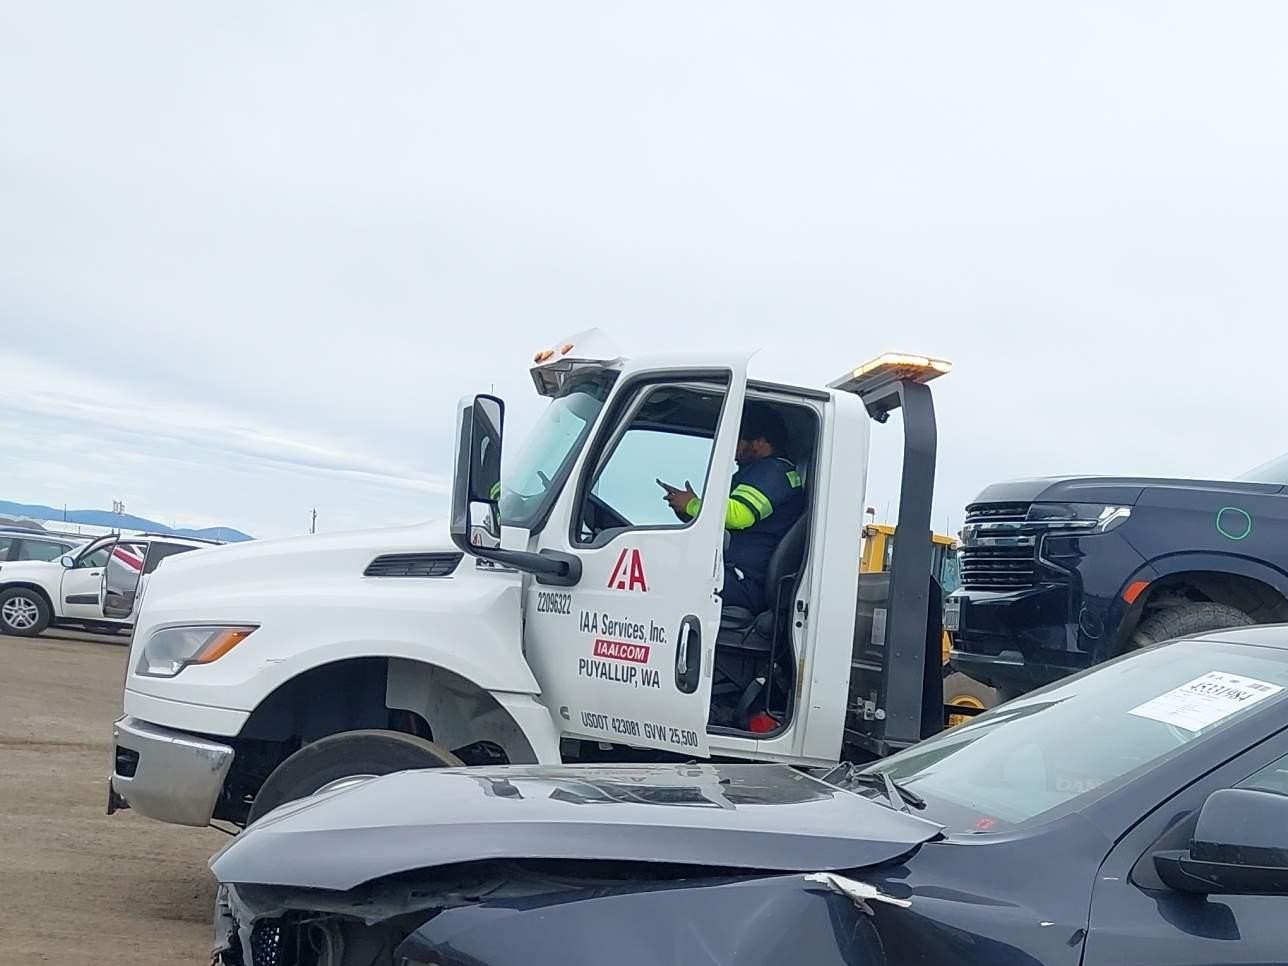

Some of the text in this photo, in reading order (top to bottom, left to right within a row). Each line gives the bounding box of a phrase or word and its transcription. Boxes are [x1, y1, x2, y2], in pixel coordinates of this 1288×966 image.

[537, 591, 572, 614] 22096322
[579, 610, 667, 643] IAA Services, Inc.
[597, 643, 645, 661] IAAI.COM
[579, 658, 660, 689] PUYALLUP, WA
[581, 711, 698, 747] USDOT 423081 GVW 25,500
